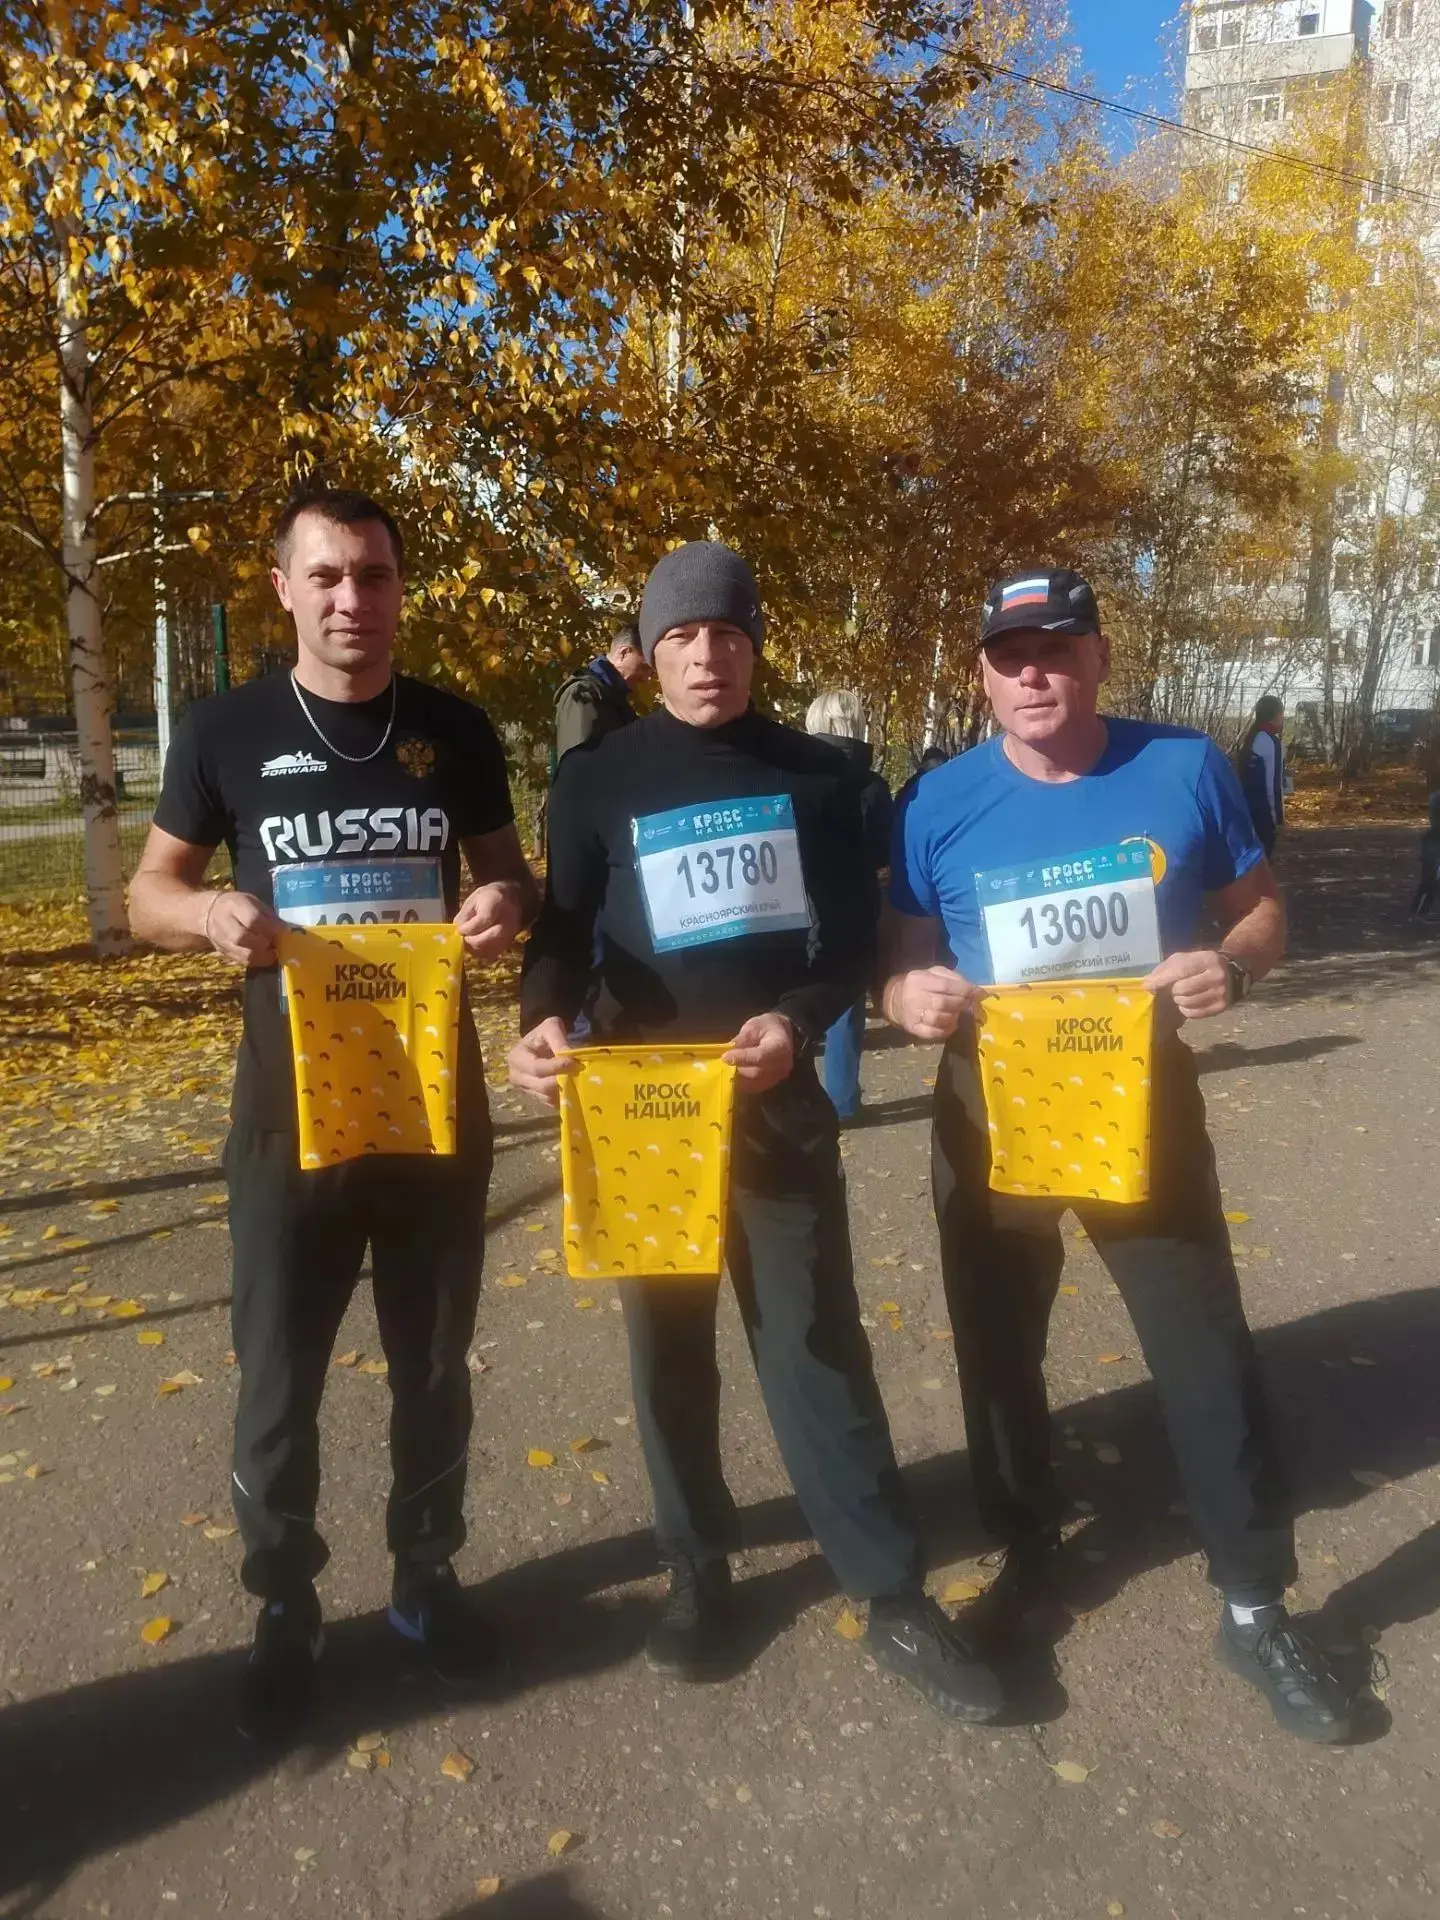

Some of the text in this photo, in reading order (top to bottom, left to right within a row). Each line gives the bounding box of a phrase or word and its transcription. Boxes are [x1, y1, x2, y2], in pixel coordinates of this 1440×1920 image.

[261, 764, 328, 778] FORWARD
[692, 808, 742, 829] КРОСС
[259, 807, 450, 862] RUSSIA
[695, 822, 744, 836] НАЦИИ
[676, 840, 778, 898] 13780
[1041, 860, 1093, 881] КРОСС
[340, 872, 392, 888] КРОСС
[1043, 874, 1095, 888] НАЦИИ
[341, 886, 393, 896] НАЦИИ
[680, 901, 759, 928] КРАСНОЯРСКИЙ
[1019, 891, 1129, 949] 13600
[335, 962, 397, 982] КРОСС
[1021, 952, 1131, 977] КРАСНОЯРСКИЙ КРАЙ
[325, 981, 407, 1002] НАЦИИ
[1056, 1016, 1113, 1035] КРОСС
[1047, 1035, 1124, 1054] НАЦИИ
[633, 1083, 691, 1101] КРОСС
[624, 1100, 701, 1121] НАЦИИ
